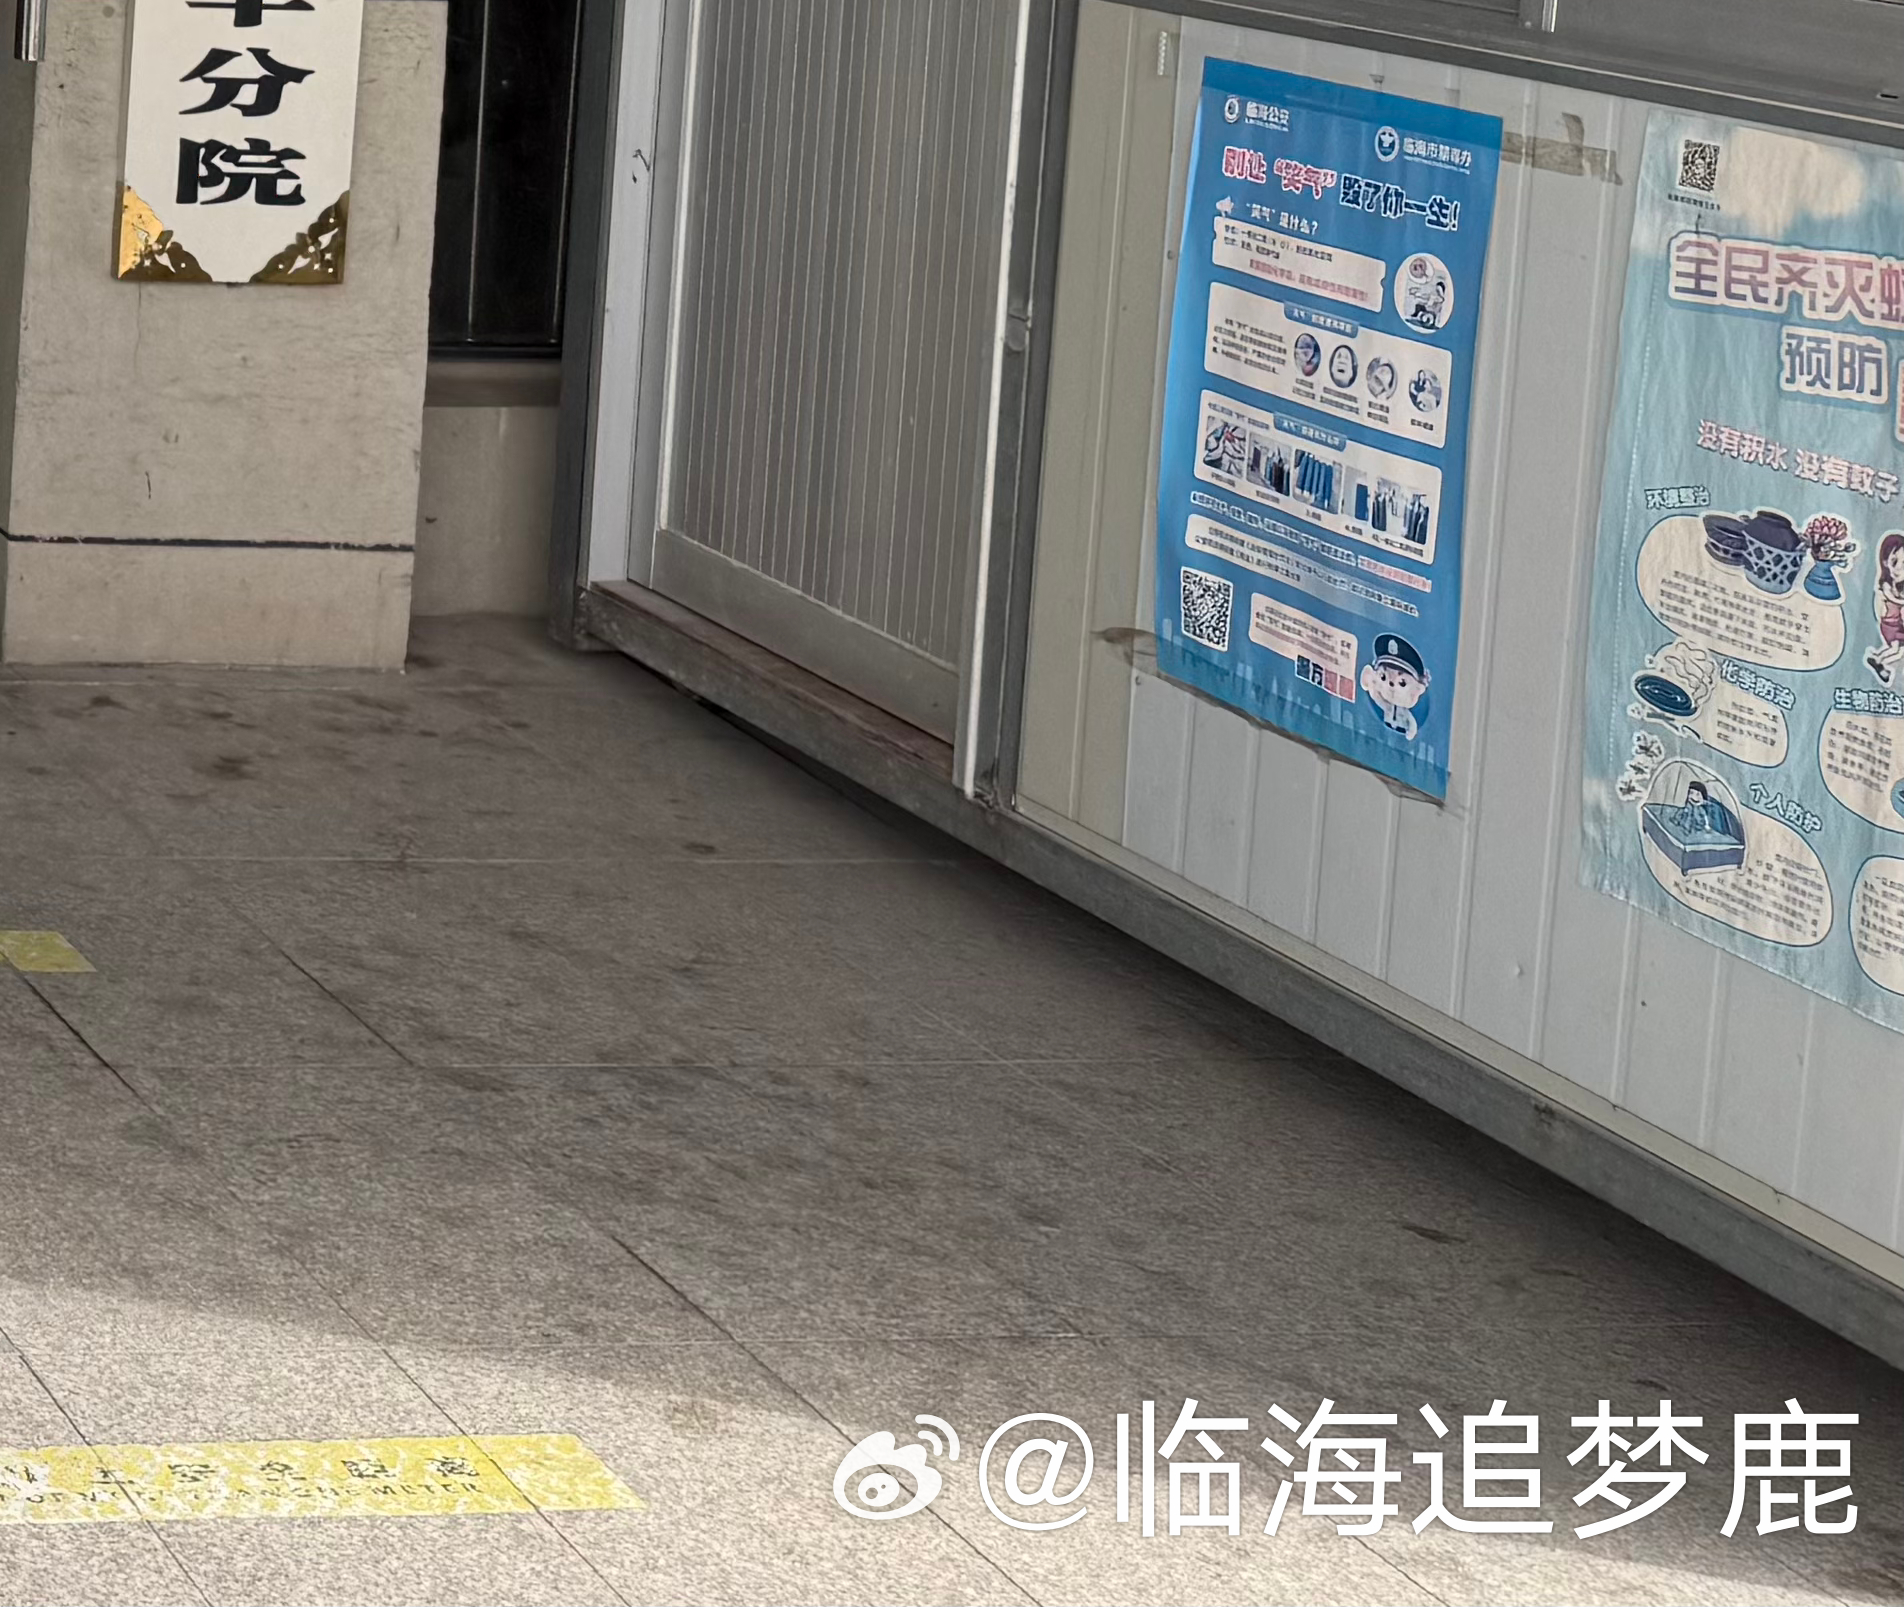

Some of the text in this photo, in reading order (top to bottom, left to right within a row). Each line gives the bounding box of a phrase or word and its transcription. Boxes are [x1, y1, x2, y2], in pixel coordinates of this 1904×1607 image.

[1785, 332, 1883, 397] 预防
[1697, 419, 1789, 472] 没有积水
[1750, 783, 1822, 833] 个人防护
